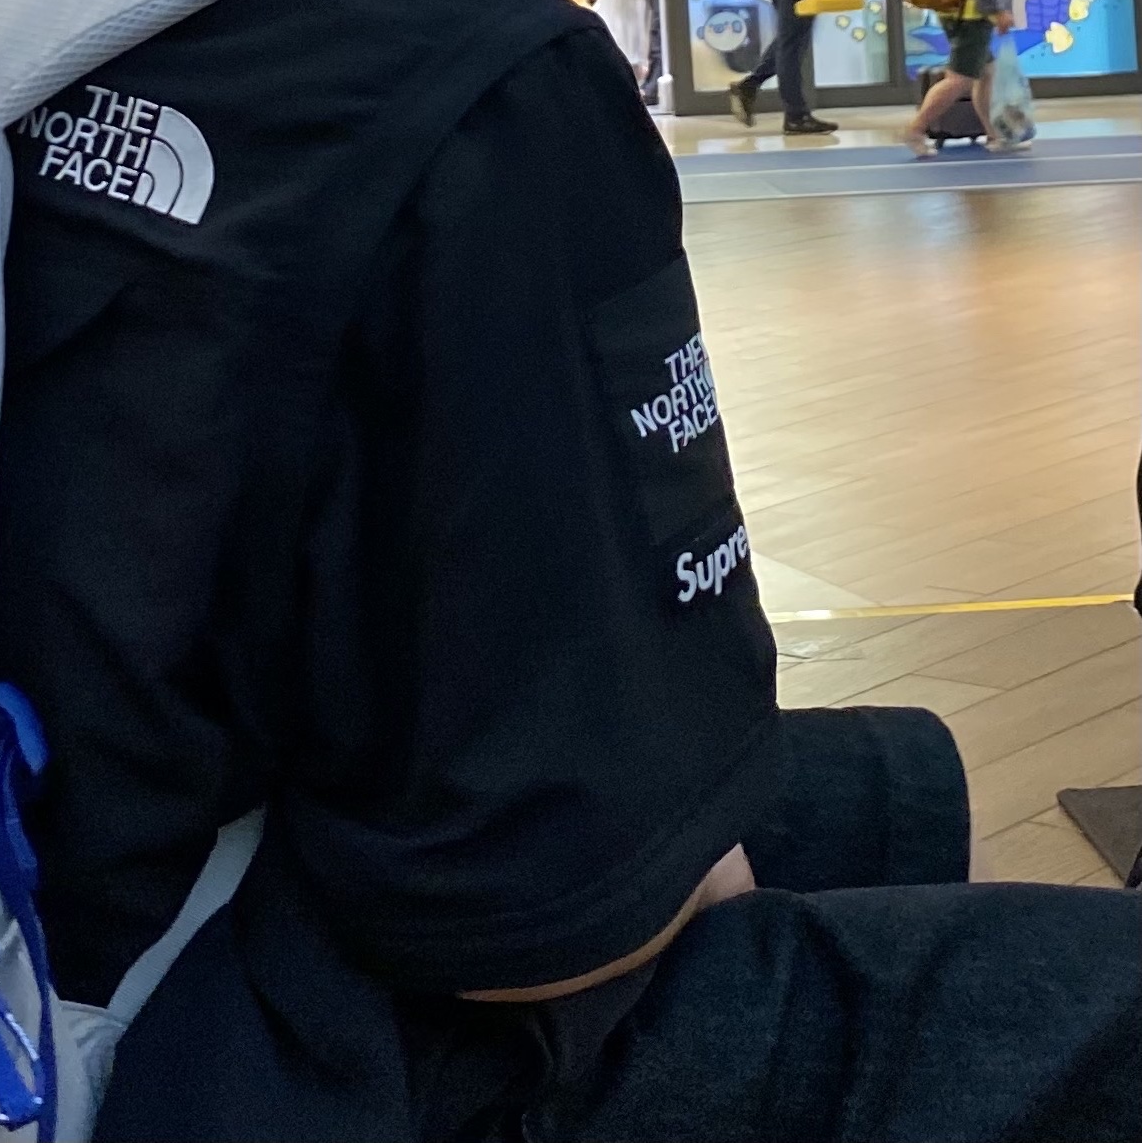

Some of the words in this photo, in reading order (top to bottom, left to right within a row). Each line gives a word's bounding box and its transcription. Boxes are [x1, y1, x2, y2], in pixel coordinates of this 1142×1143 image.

[16, 106, 149, 170] NORTH
[85, 84, 159, 135] THE
[37, 144, 139, 201] FACE
[664, 332, 705, 384] THE
[630, 362, 711, 437] NORTH
[667, 391, 719, 453] FACE
